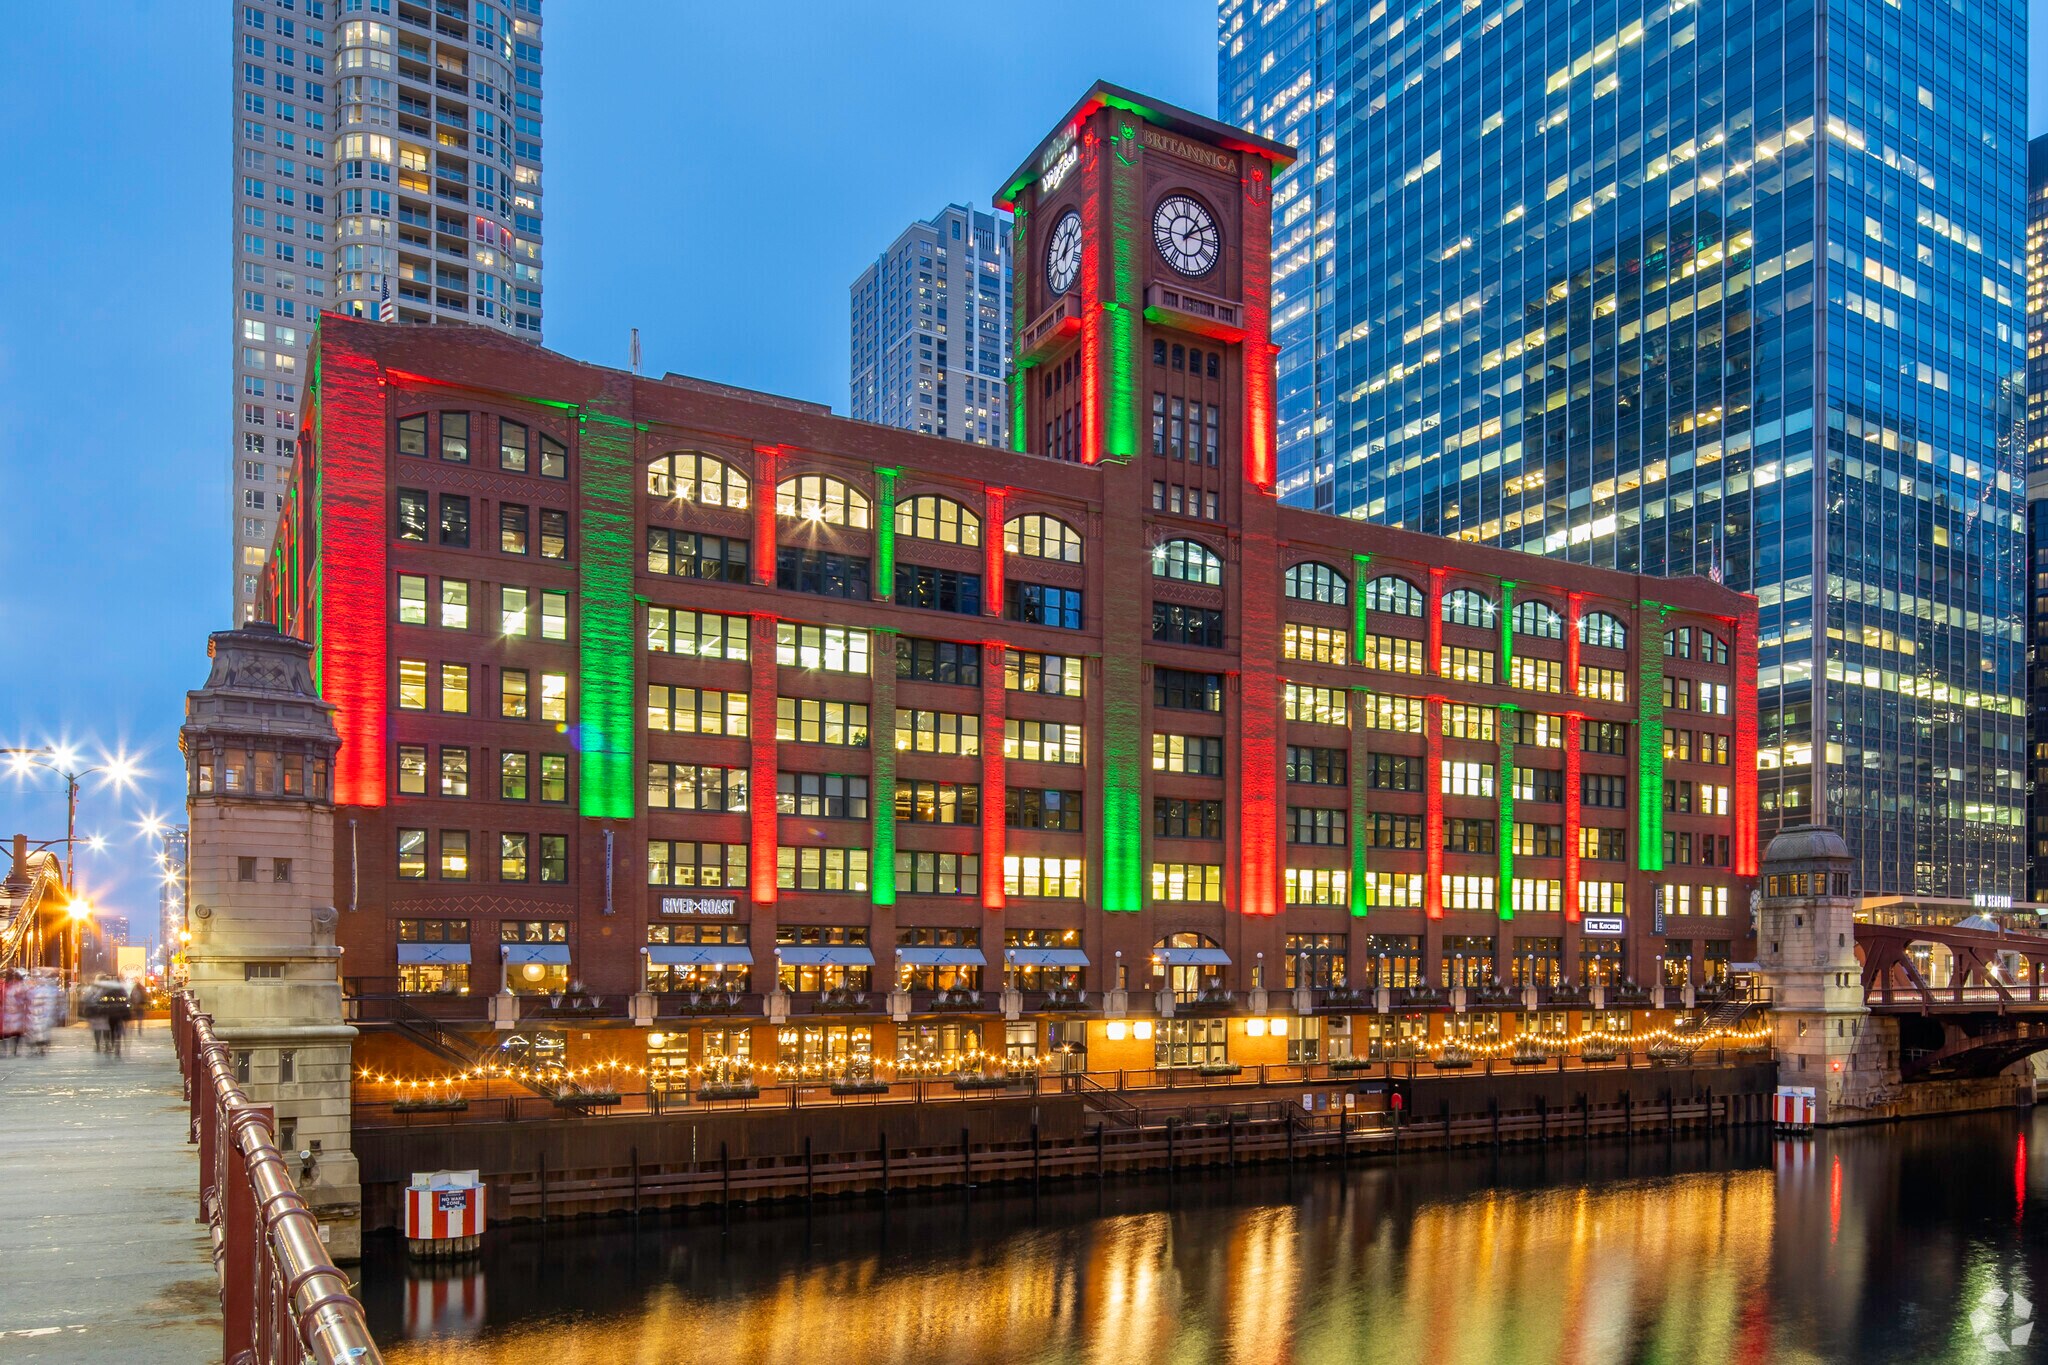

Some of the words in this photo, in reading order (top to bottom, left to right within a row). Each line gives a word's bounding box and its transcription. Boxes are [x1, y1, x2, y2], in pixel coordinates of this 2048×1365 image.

[1143, 130, 1238, 173] BRITANNICA
[662, 897, 694, 913] RIVER
[701, 898, 735, 914] ROAST
[1988, 895, 2012, 908] SEAFOOD
